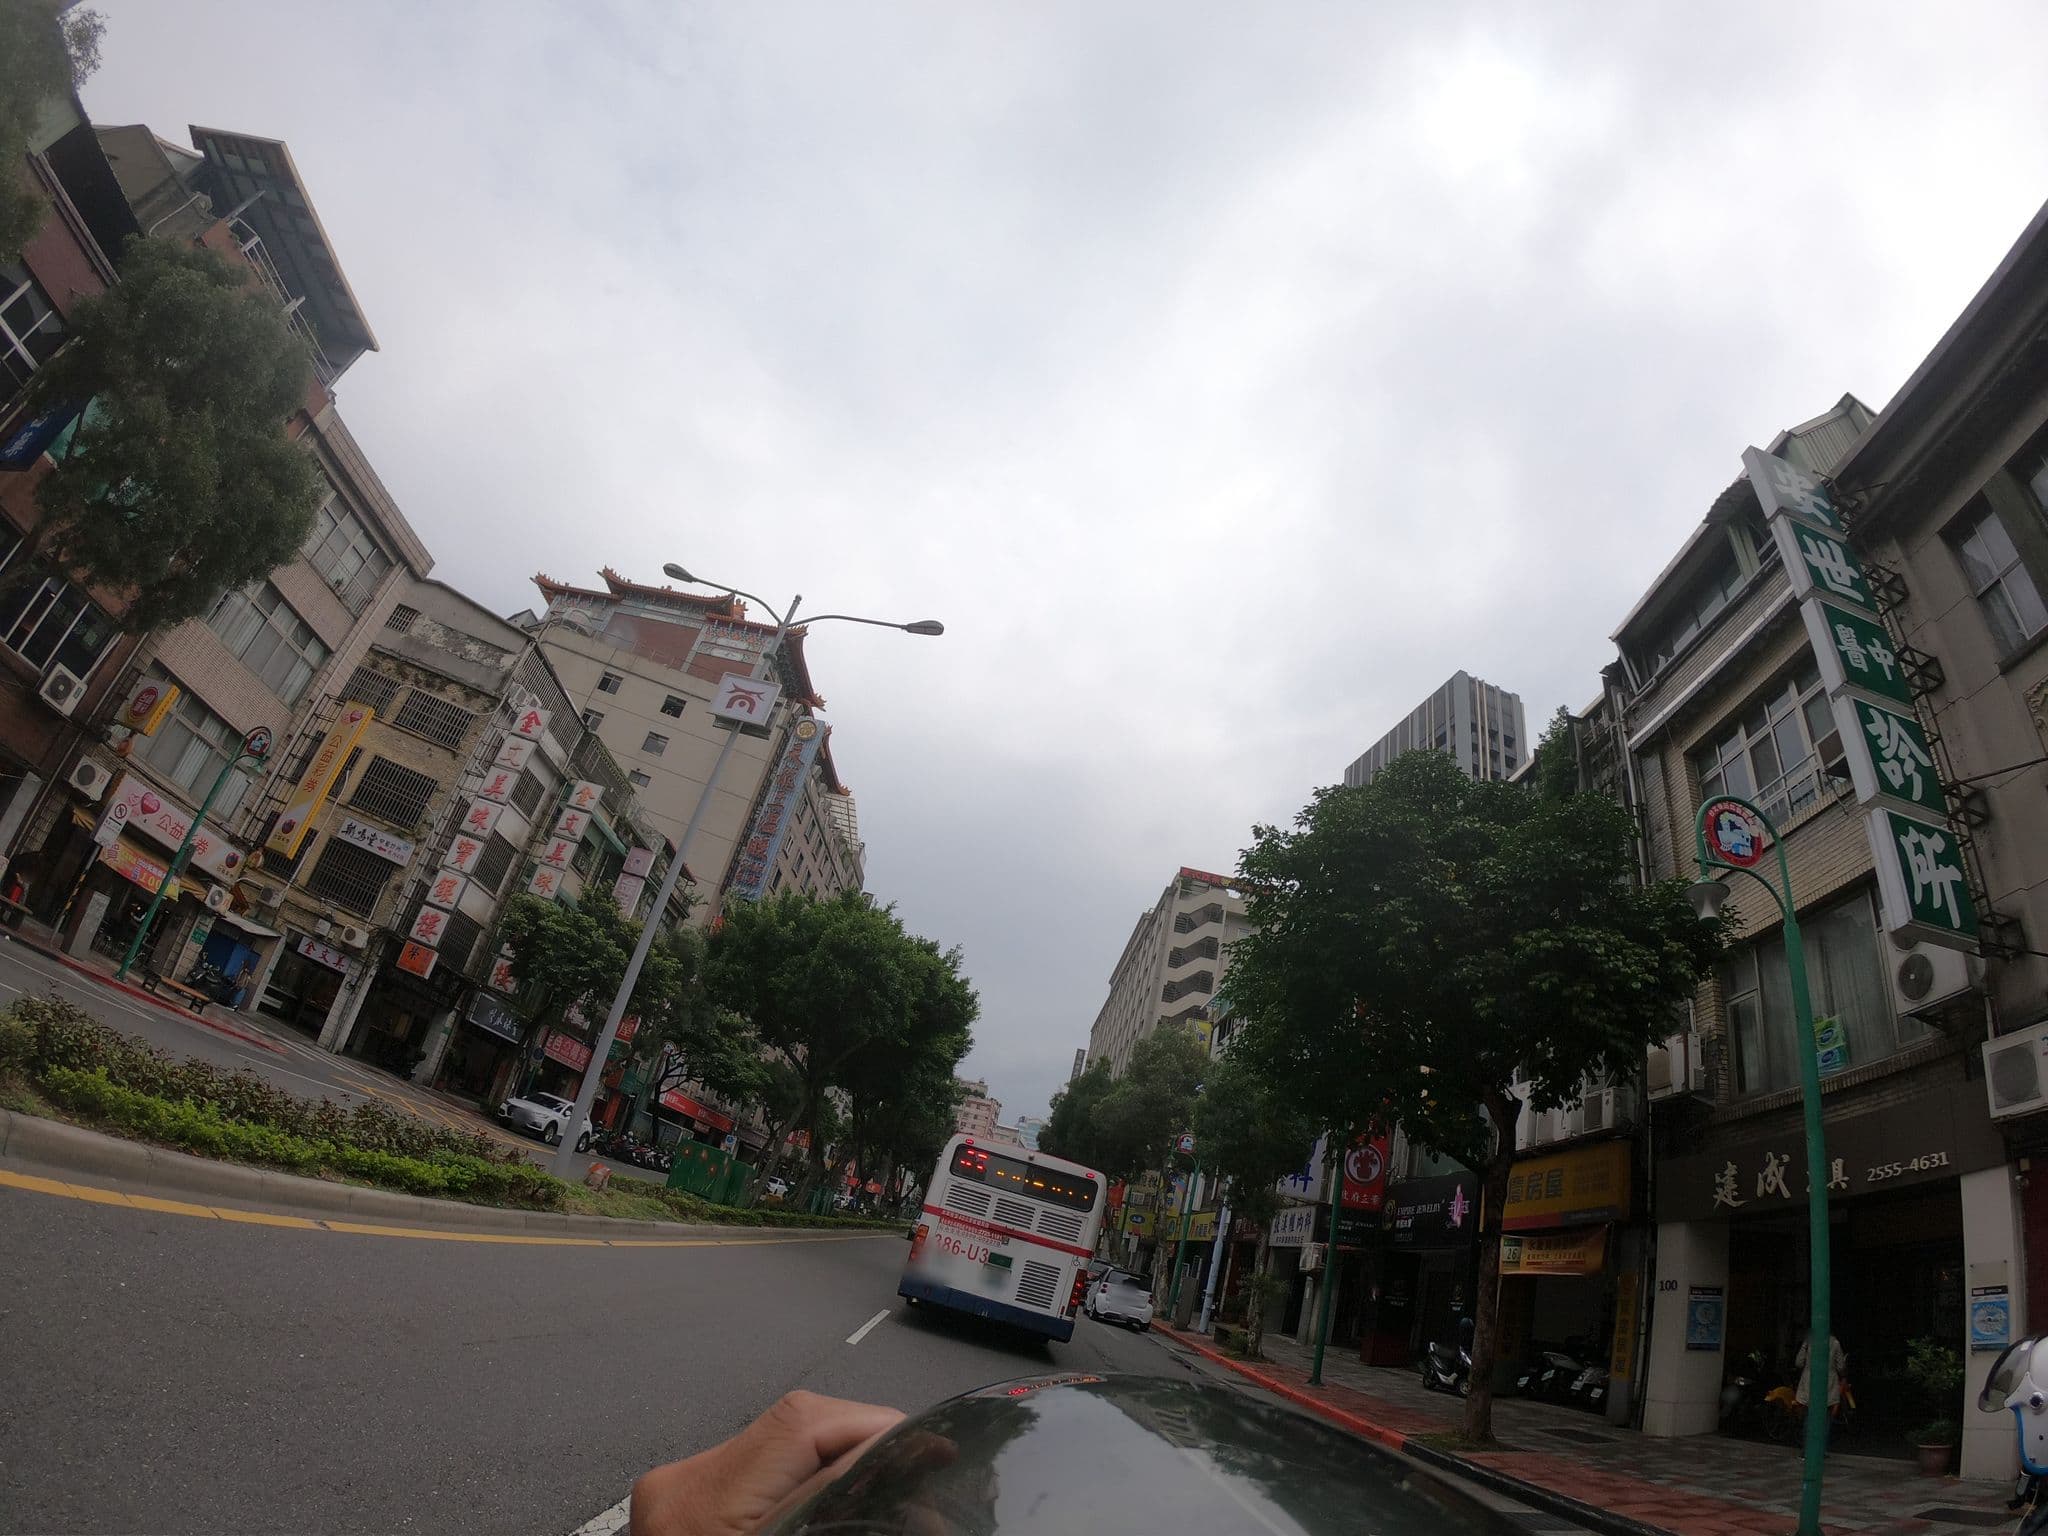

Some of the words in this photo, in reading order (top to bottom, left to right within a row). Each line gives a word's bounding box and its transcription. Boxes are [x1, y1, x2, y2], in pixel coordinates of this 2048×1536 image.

[302, 940, 346, 969] 金文美
[1712, 1150, 1850, 1210] 建成具
[1866, 1151, 1951, 1183] 2555-4631
[1659, 1279, 1678, 1291] 100
